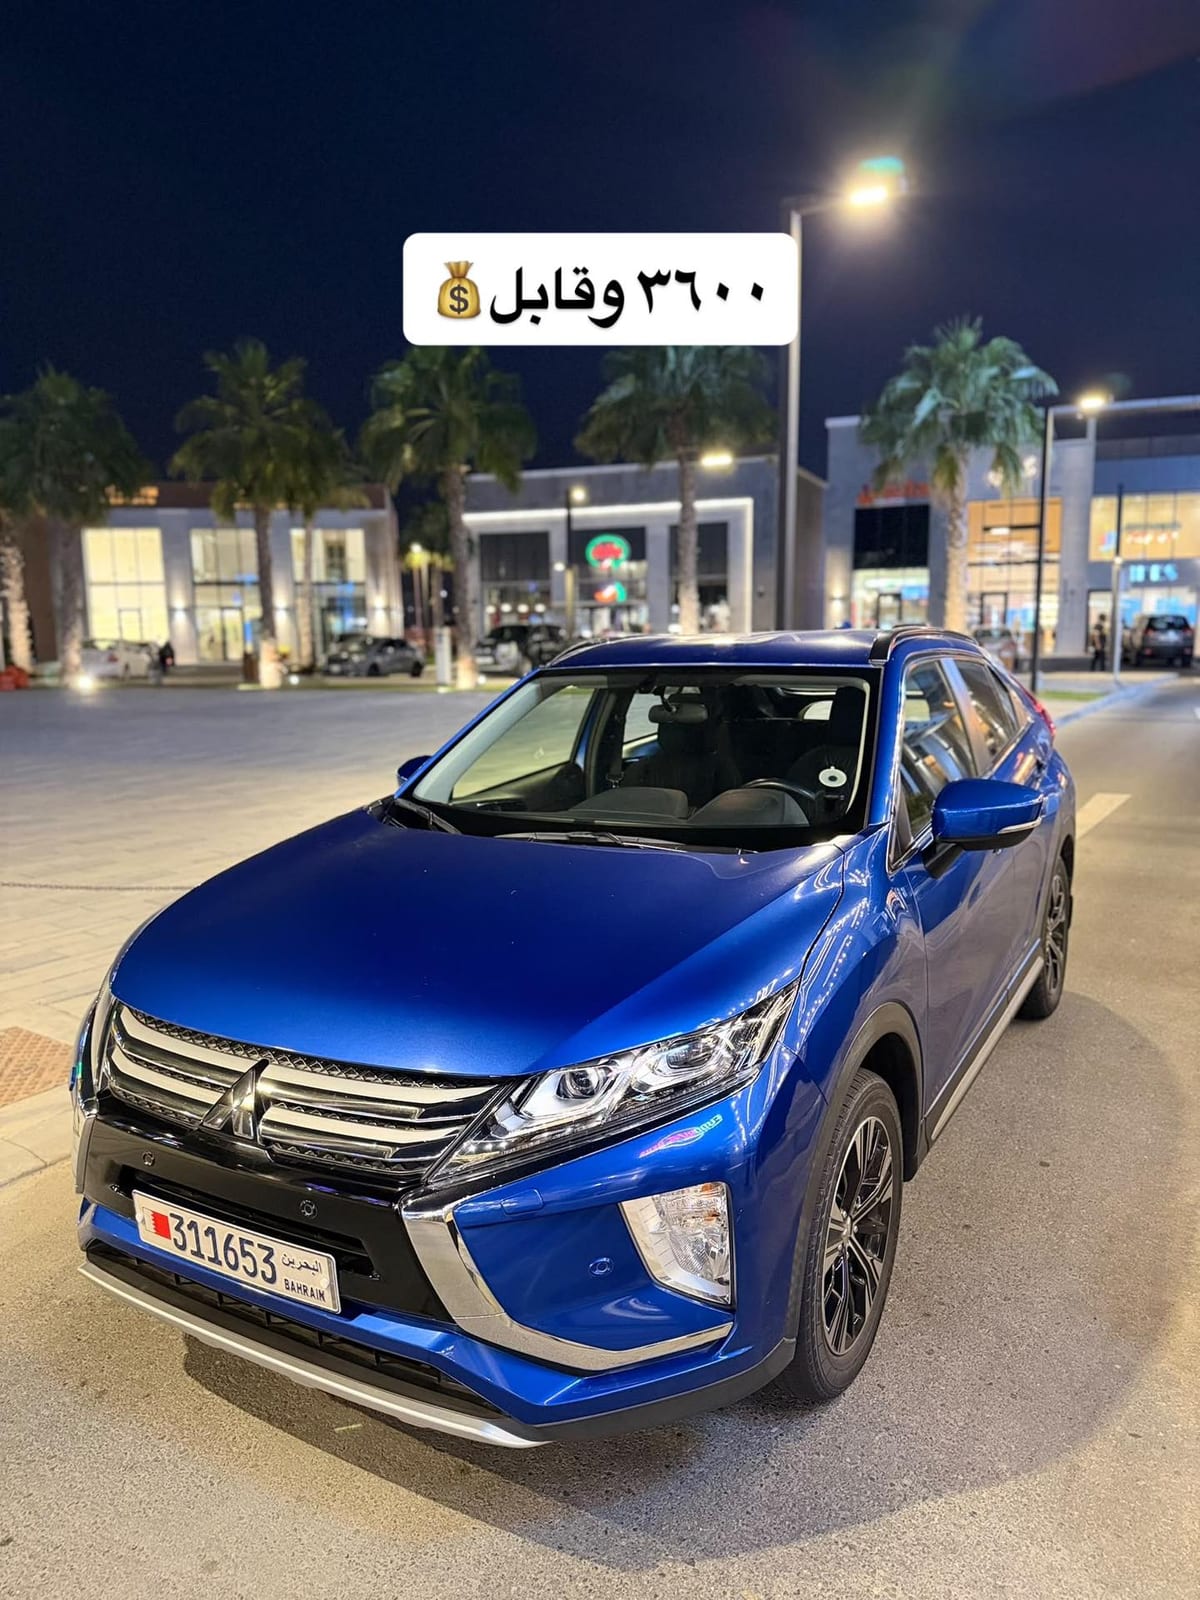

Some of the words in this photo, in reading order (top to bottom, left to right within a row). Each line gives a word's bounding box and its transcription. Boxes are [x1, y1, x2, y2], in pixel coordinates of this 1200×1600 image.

[169, 1212, 277, 1285] 311653
[281, 1253, 323, 1276] البحرين
[284, 1278, 326, 1303] BAHRAIN
